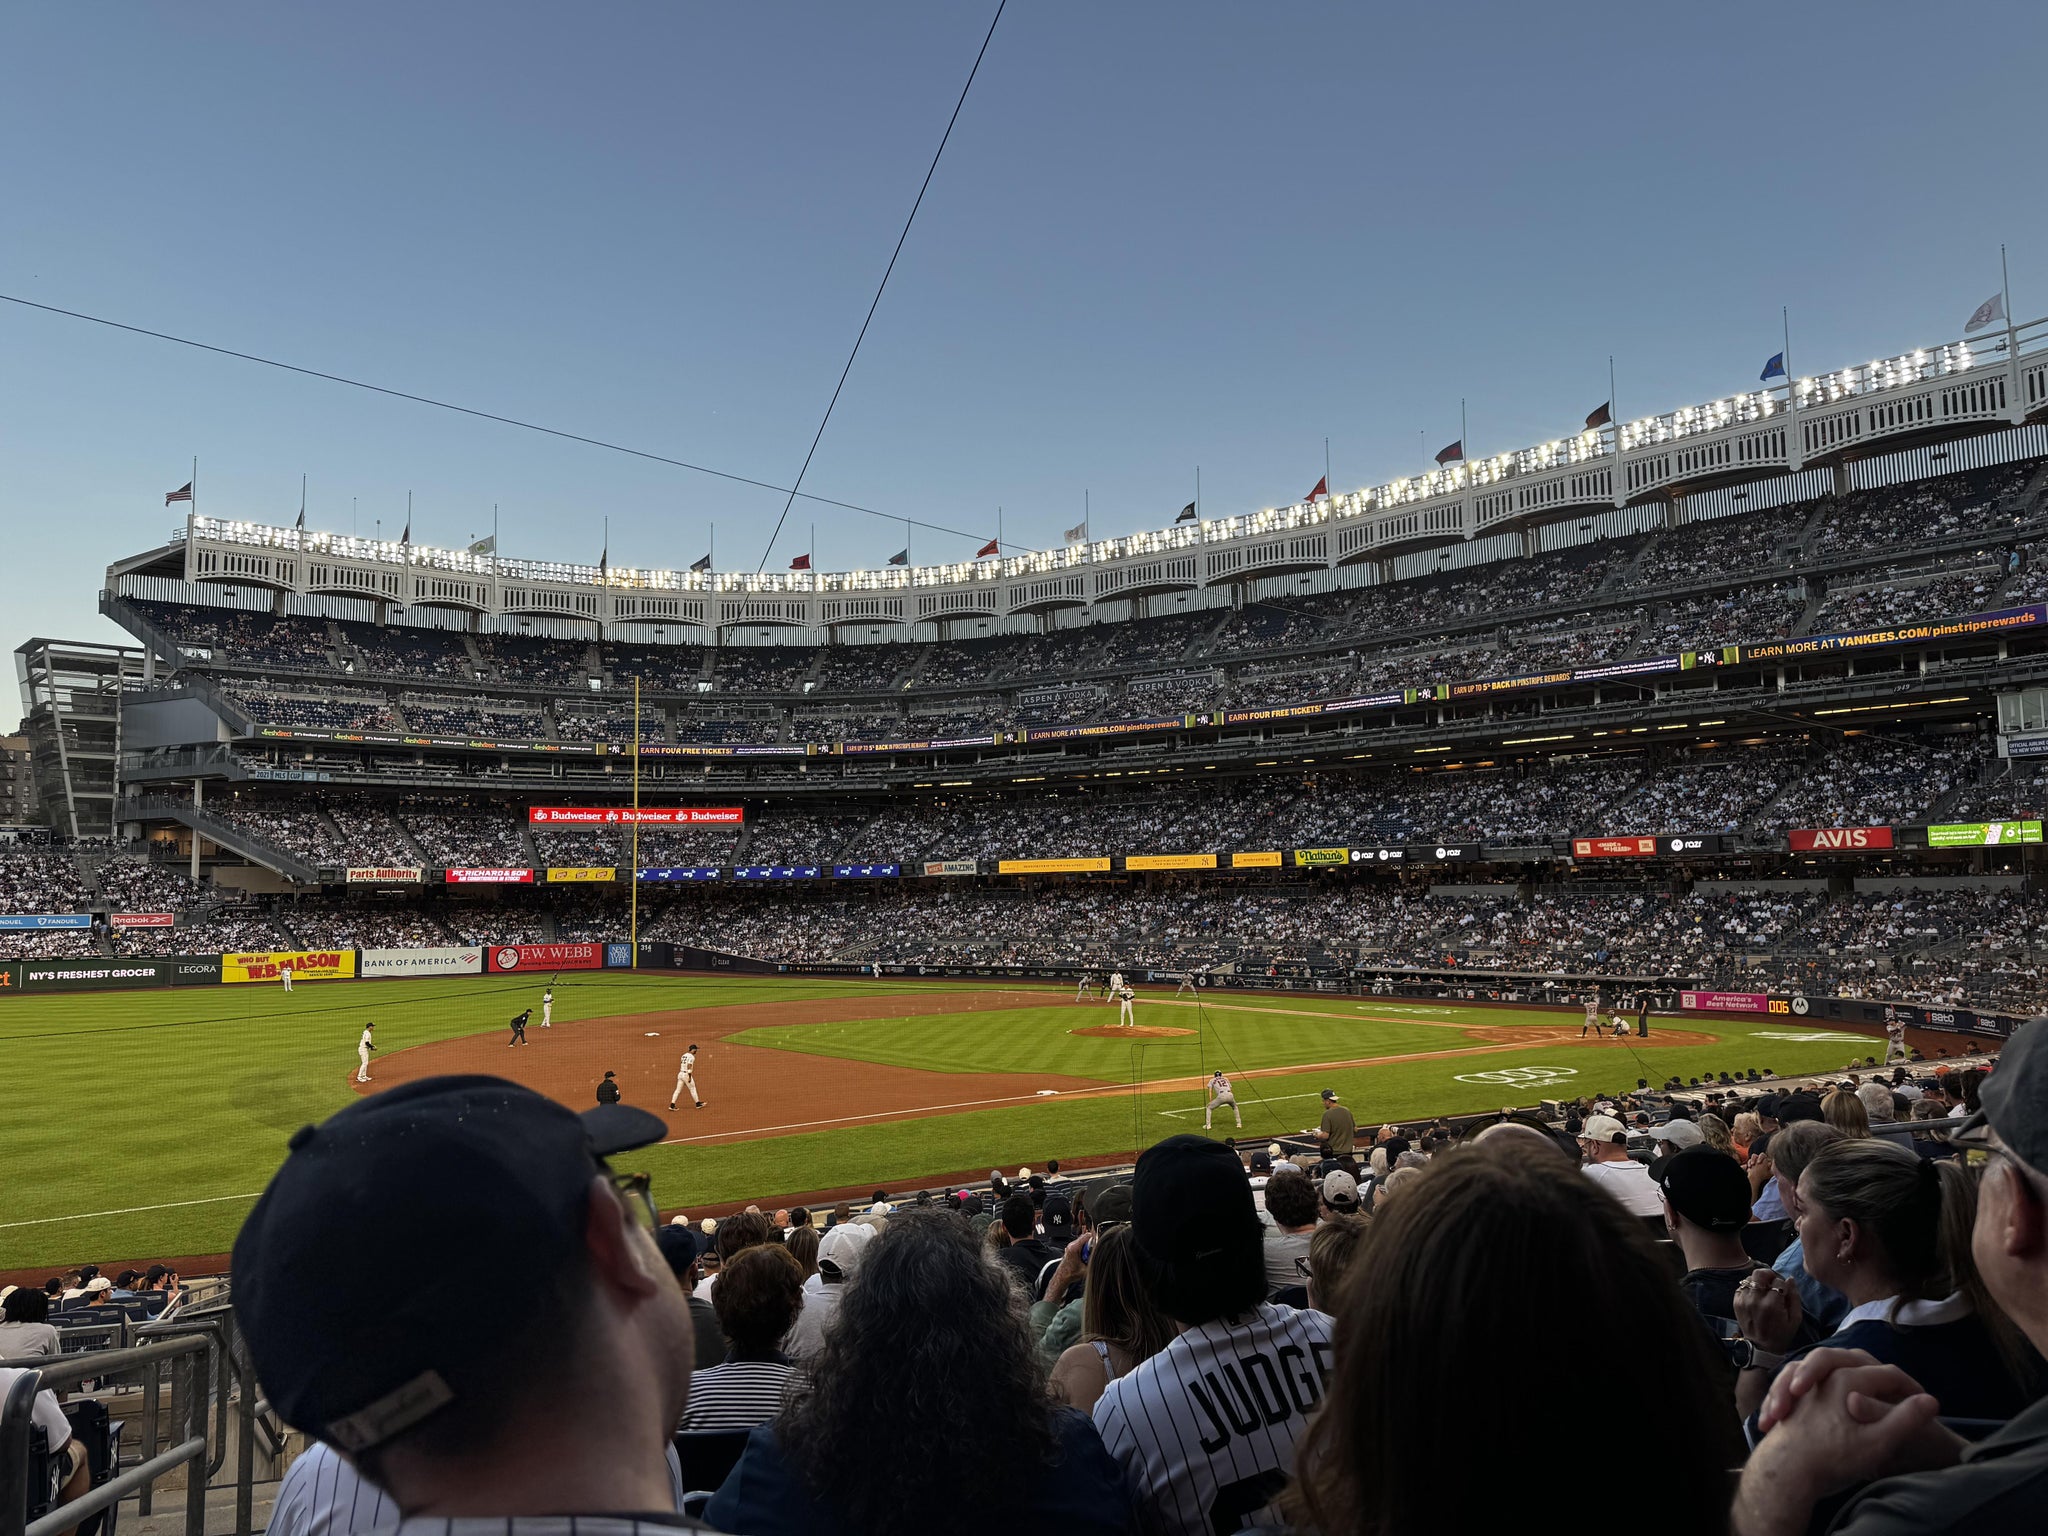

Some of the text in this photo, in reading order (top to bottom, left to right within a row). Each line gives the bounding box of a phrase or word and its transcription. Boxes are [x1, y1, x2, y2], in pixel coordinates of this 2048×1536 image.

[1748, 612, 2036, 659] LEARN MORE AT YANKEES.COM/pinstriperewards
[1132, 677, 1208, 692] ASPEN VODKA
[1453, 685, 1467, 695] EARN
[1467, 685, 1475, 693] UP
[1475, 683, 1482, 692] TO
[1492, 681, 1511, 690] BACK
[1511, 679, 1517, 687] IN
[1517, 676, 1543, 686] PINSTRIPE
[1023, 690, 1093, 704] ASPEN VODKA
[1228, 713, 1249, 722] EARN
[1249, 711, 1271, 720] FOUR
[1271, 709, 1290, 718] FREE
[1030, 720, 1180, 740] LEARN MORE AT YANKEES.COM/pinstriperewards
[661, 747, 682, 755] FOUR
[682, 747, 700, 755] FREE
[551, 811, 602, 820] Budweiser
[622, 812, 671, 821] Budweiser
[691, 812, 739, 821] Budweiser
[1685, 840, 1702, 849] razr
[1813, 829, 1867, 848] AVIS
[1300, 849, 1344, 862] Nathan's
[1389, 850, 1402, 858] razr
[350, 869, 418, 878] Parts Authority
[521, 948, 546, 960] F.W.
[550, 946, 592, 958] WEBB
[279, 953, 341, 972] MASON
[411, 957, 457, 965] AMERICA
[29, 968, 155, 980] NY'S FRESHEST GROCER
[1768, 1001, 1789, 1013] 006
[1932, 1013, 1954, 1022] sato
[1981, 1019, 1996, 1027] sato
